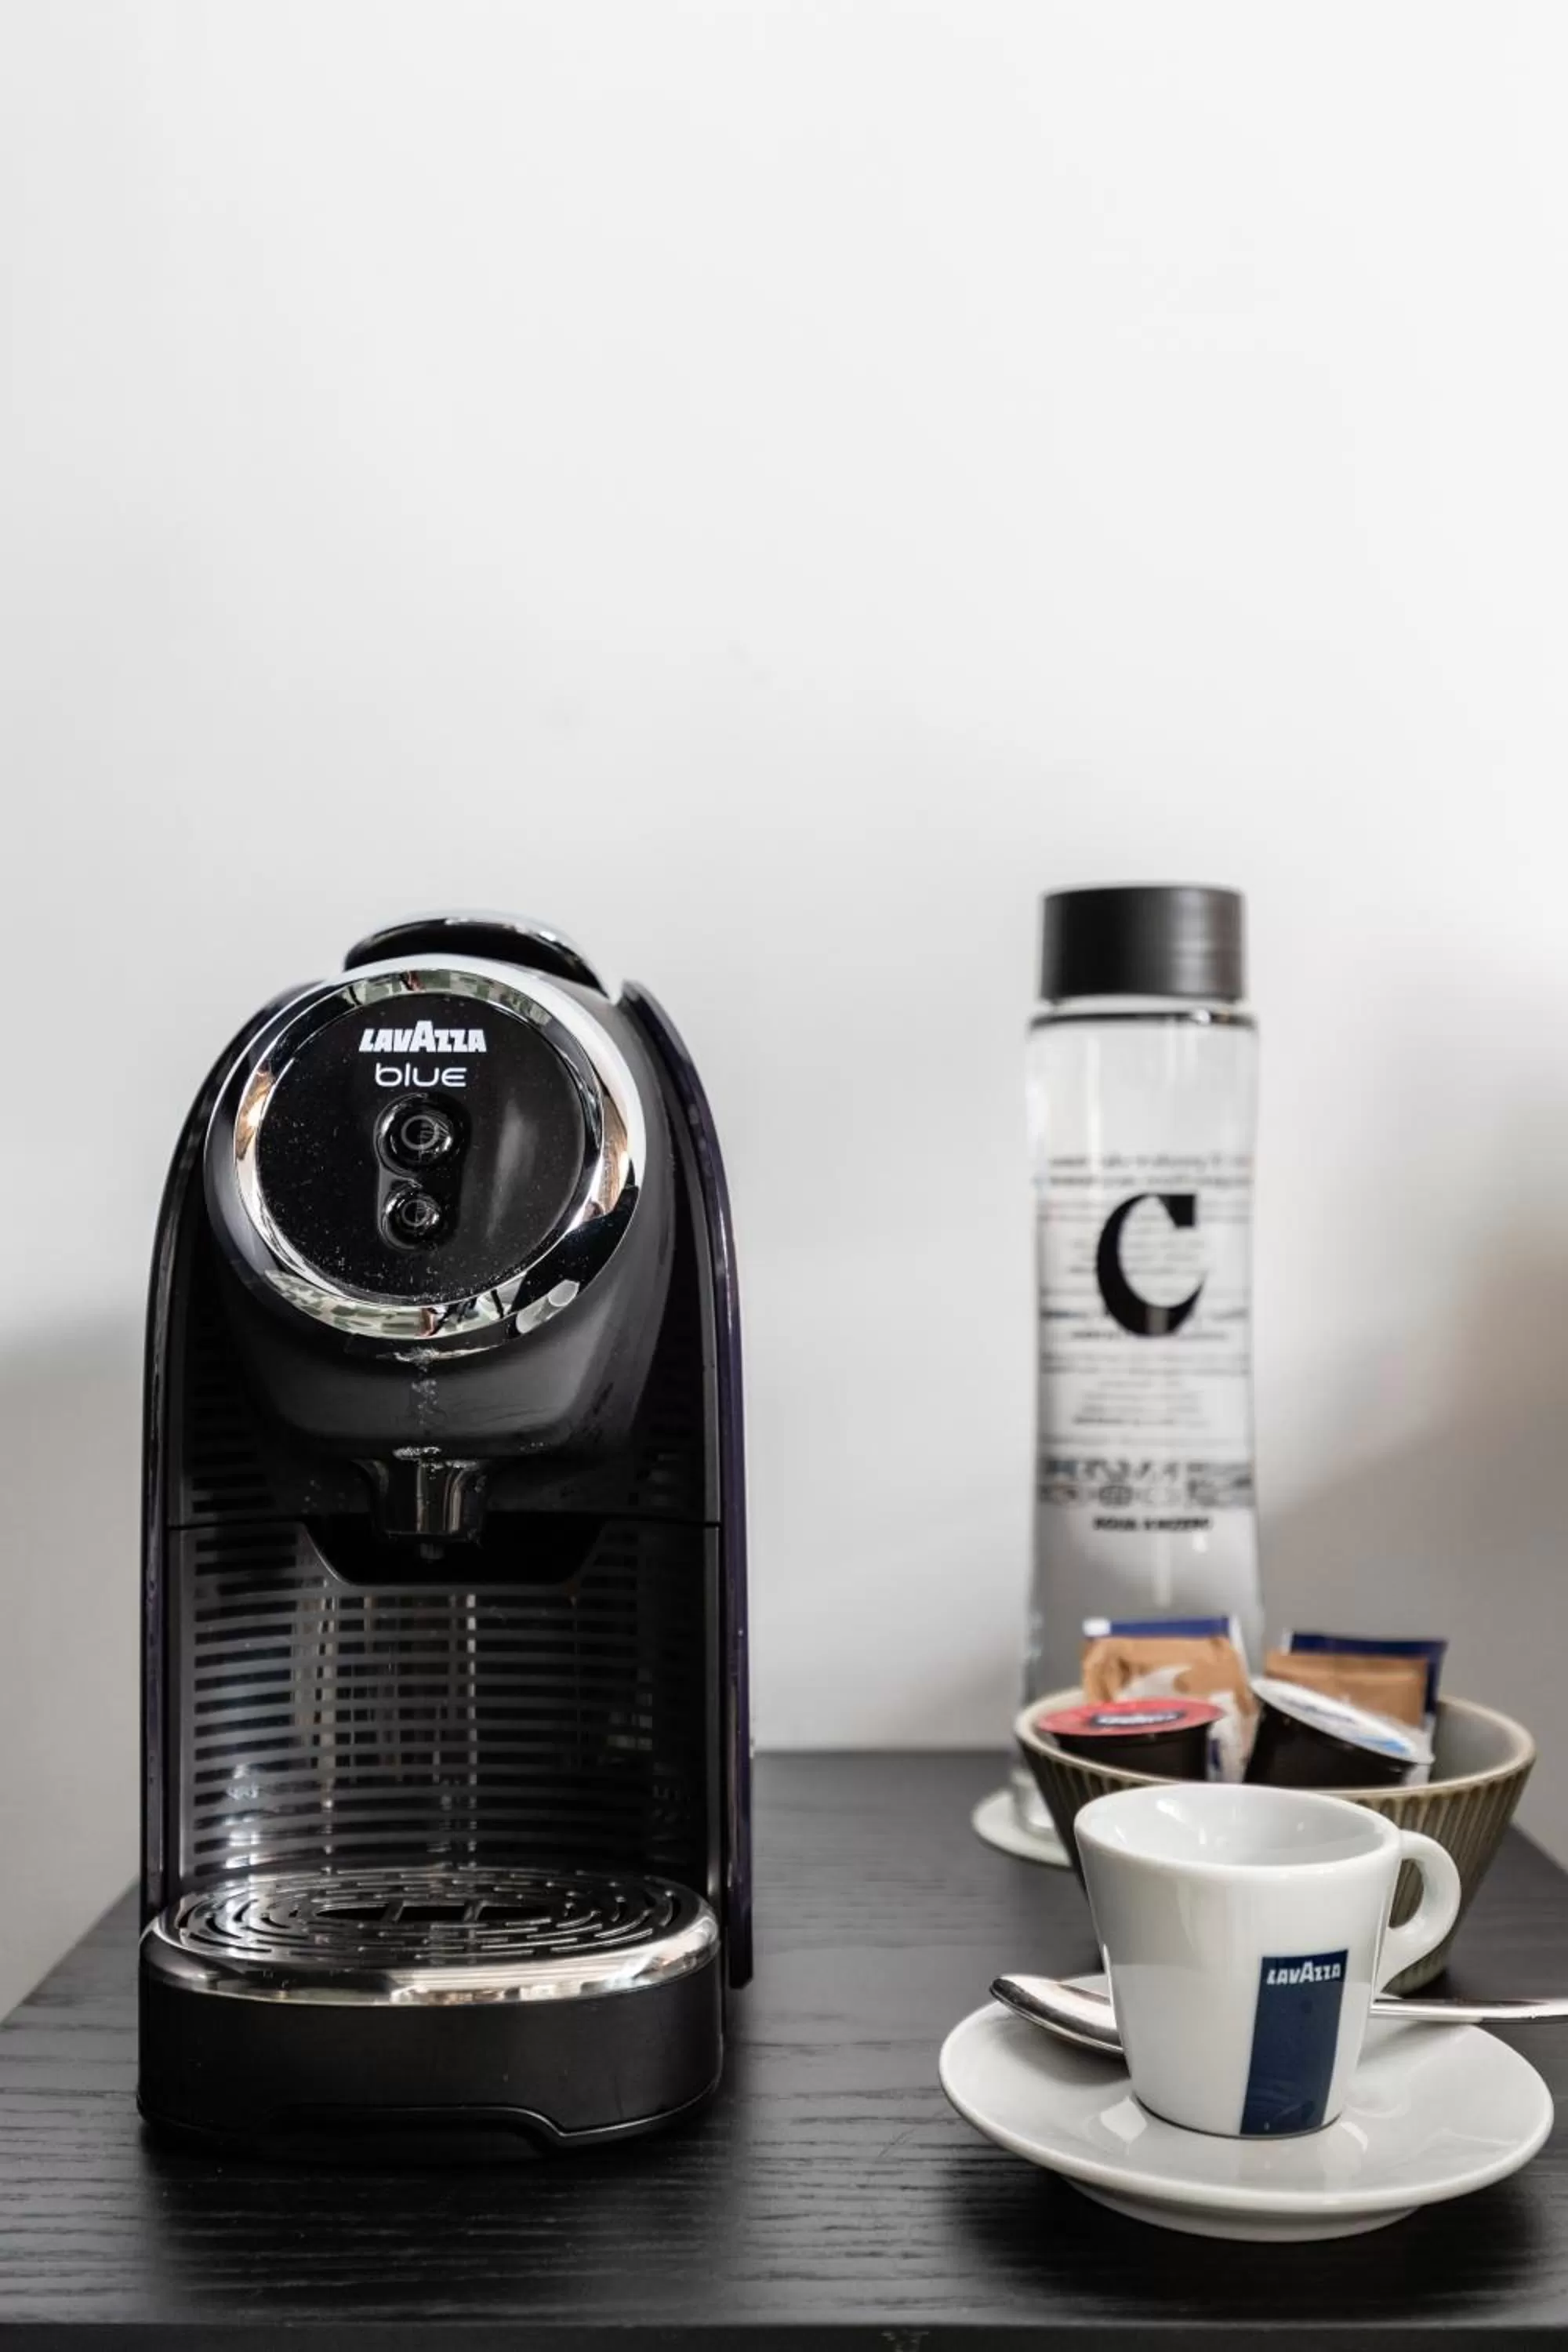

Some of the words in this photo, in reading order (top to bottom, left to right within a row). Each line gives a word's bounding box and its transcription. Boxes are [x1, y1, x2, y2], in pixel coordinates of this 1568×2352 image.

[359, 1020, 487, 1052] LAVAZZA
[375, 1062, 467, 1087] blue
[1095, 1192, 1208, 1338] C
[1266, 1960, 1341, 1984] LAVAZZA
